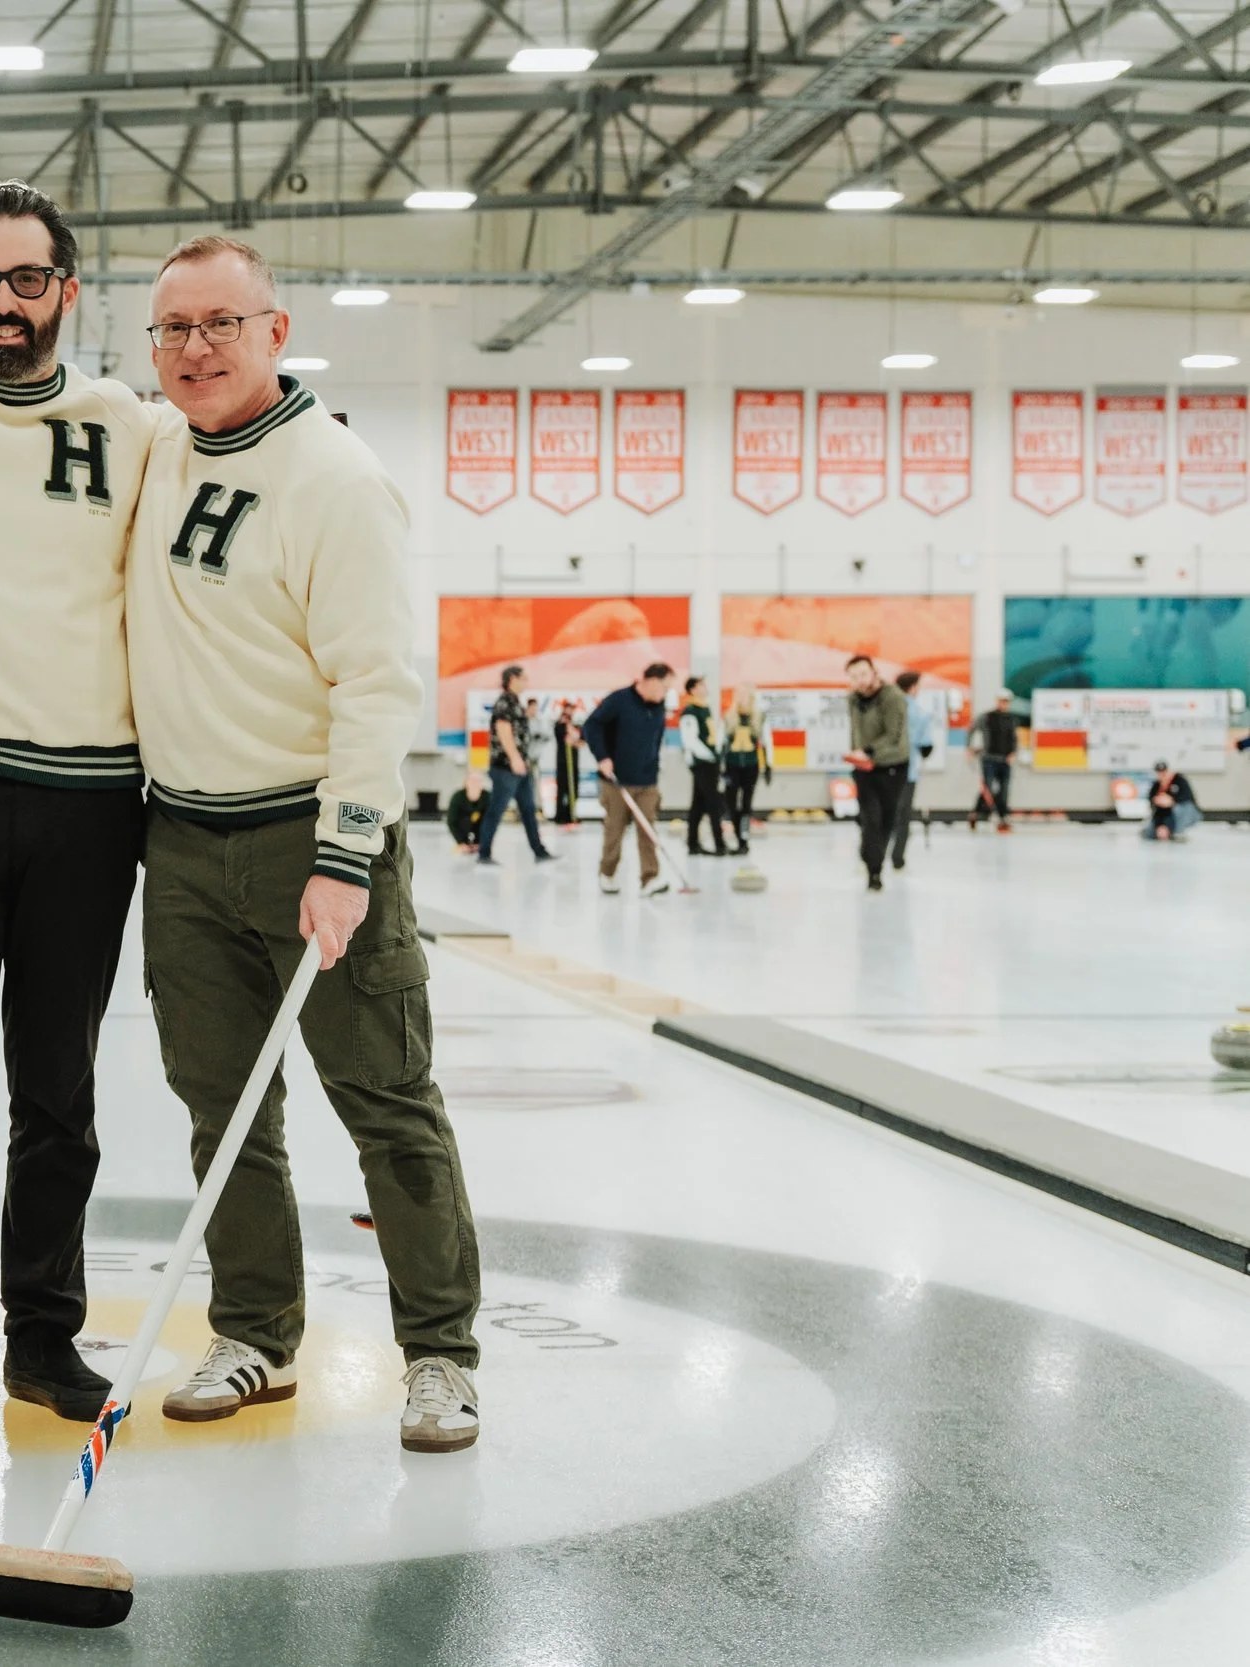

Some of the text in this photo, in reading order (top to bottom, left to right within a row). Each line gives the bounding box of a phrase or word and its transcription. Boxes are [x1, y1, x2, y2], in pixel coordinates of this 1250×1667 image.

[456, 430, 508, 453] WEST
[540, 430, 591, 453] WEST
[623, 430, 674, 453] WEST
[742, 430, 794, 453] WEST
[827, 432, 877, 454] WEST
[911, 431, 962, 454] WEST
[1023, 431, 1073, 453] WEST
[43, 418, 113, 509] H
[169, 480, 260, 578] H
[341, 805, 381, 824] HI SIGNS
